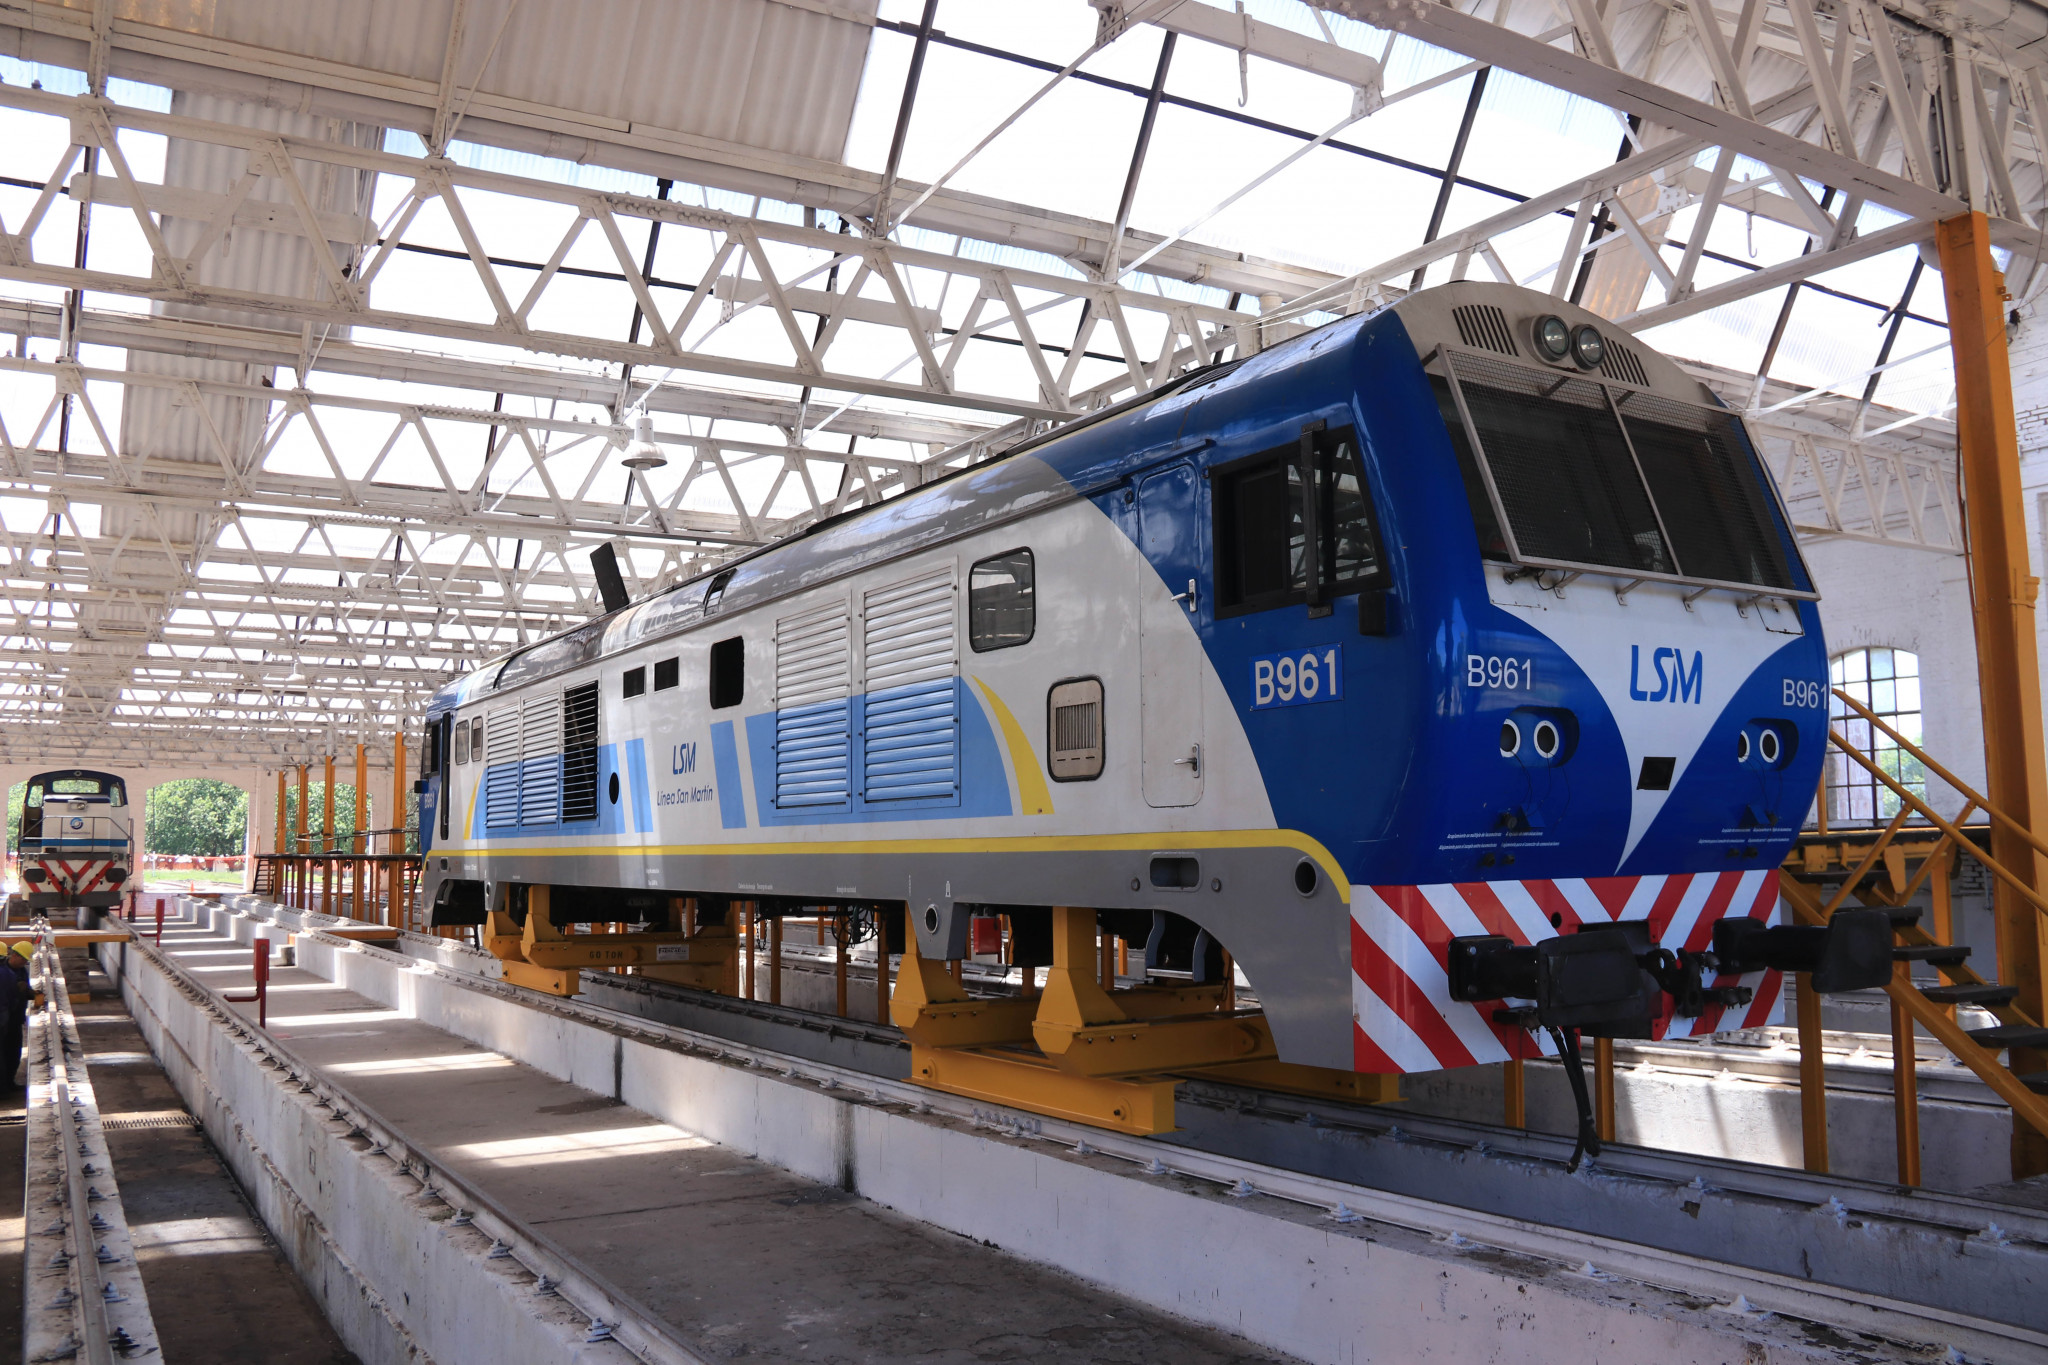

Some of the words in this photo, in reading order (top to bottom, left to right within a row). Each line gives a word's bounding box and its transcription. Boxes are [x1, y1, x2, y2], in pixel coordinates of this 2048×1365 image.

[1255, 649, 1336, 706] B961
[1467, 654, 1531, 690] B961
[1630, 645, 1703, 705] LSM
[1783, 679, 1827, 710] B961
[672, 741, 697, 775] LSM
[676, 788, 689, 804] San
[690, 784, 713, 803] Martín
[605, 950, 624, 960] TON
